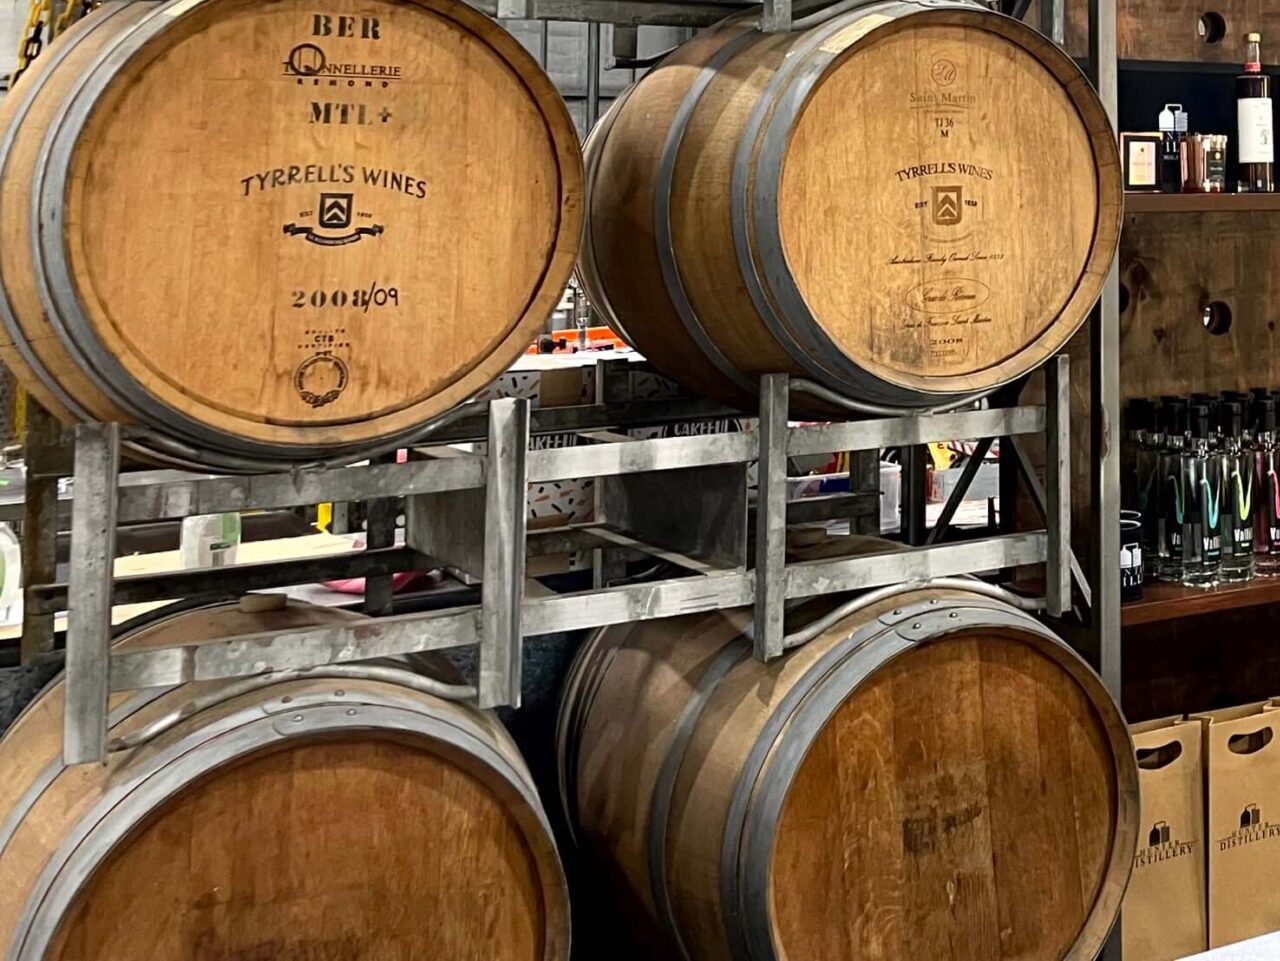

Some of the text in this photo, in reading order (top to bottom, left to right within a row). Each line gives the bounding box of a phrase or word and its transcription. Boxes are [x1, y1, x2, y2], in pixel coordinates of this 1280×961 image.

[312, 14, 381, 39] BER
[297, 79, 389, 88] REMOND
[940, 130, 949, 138] M
[241, 163, 427, 199] TYRRELL'S WINES
[895, 162, 994, 182] TYRRELL'S WINES
[1231, 821, 1269, 838] HUNTER
[1133, 844, 1194, 869] ISTILLERY
[1139, 839, 1180, 857] HUNTER
